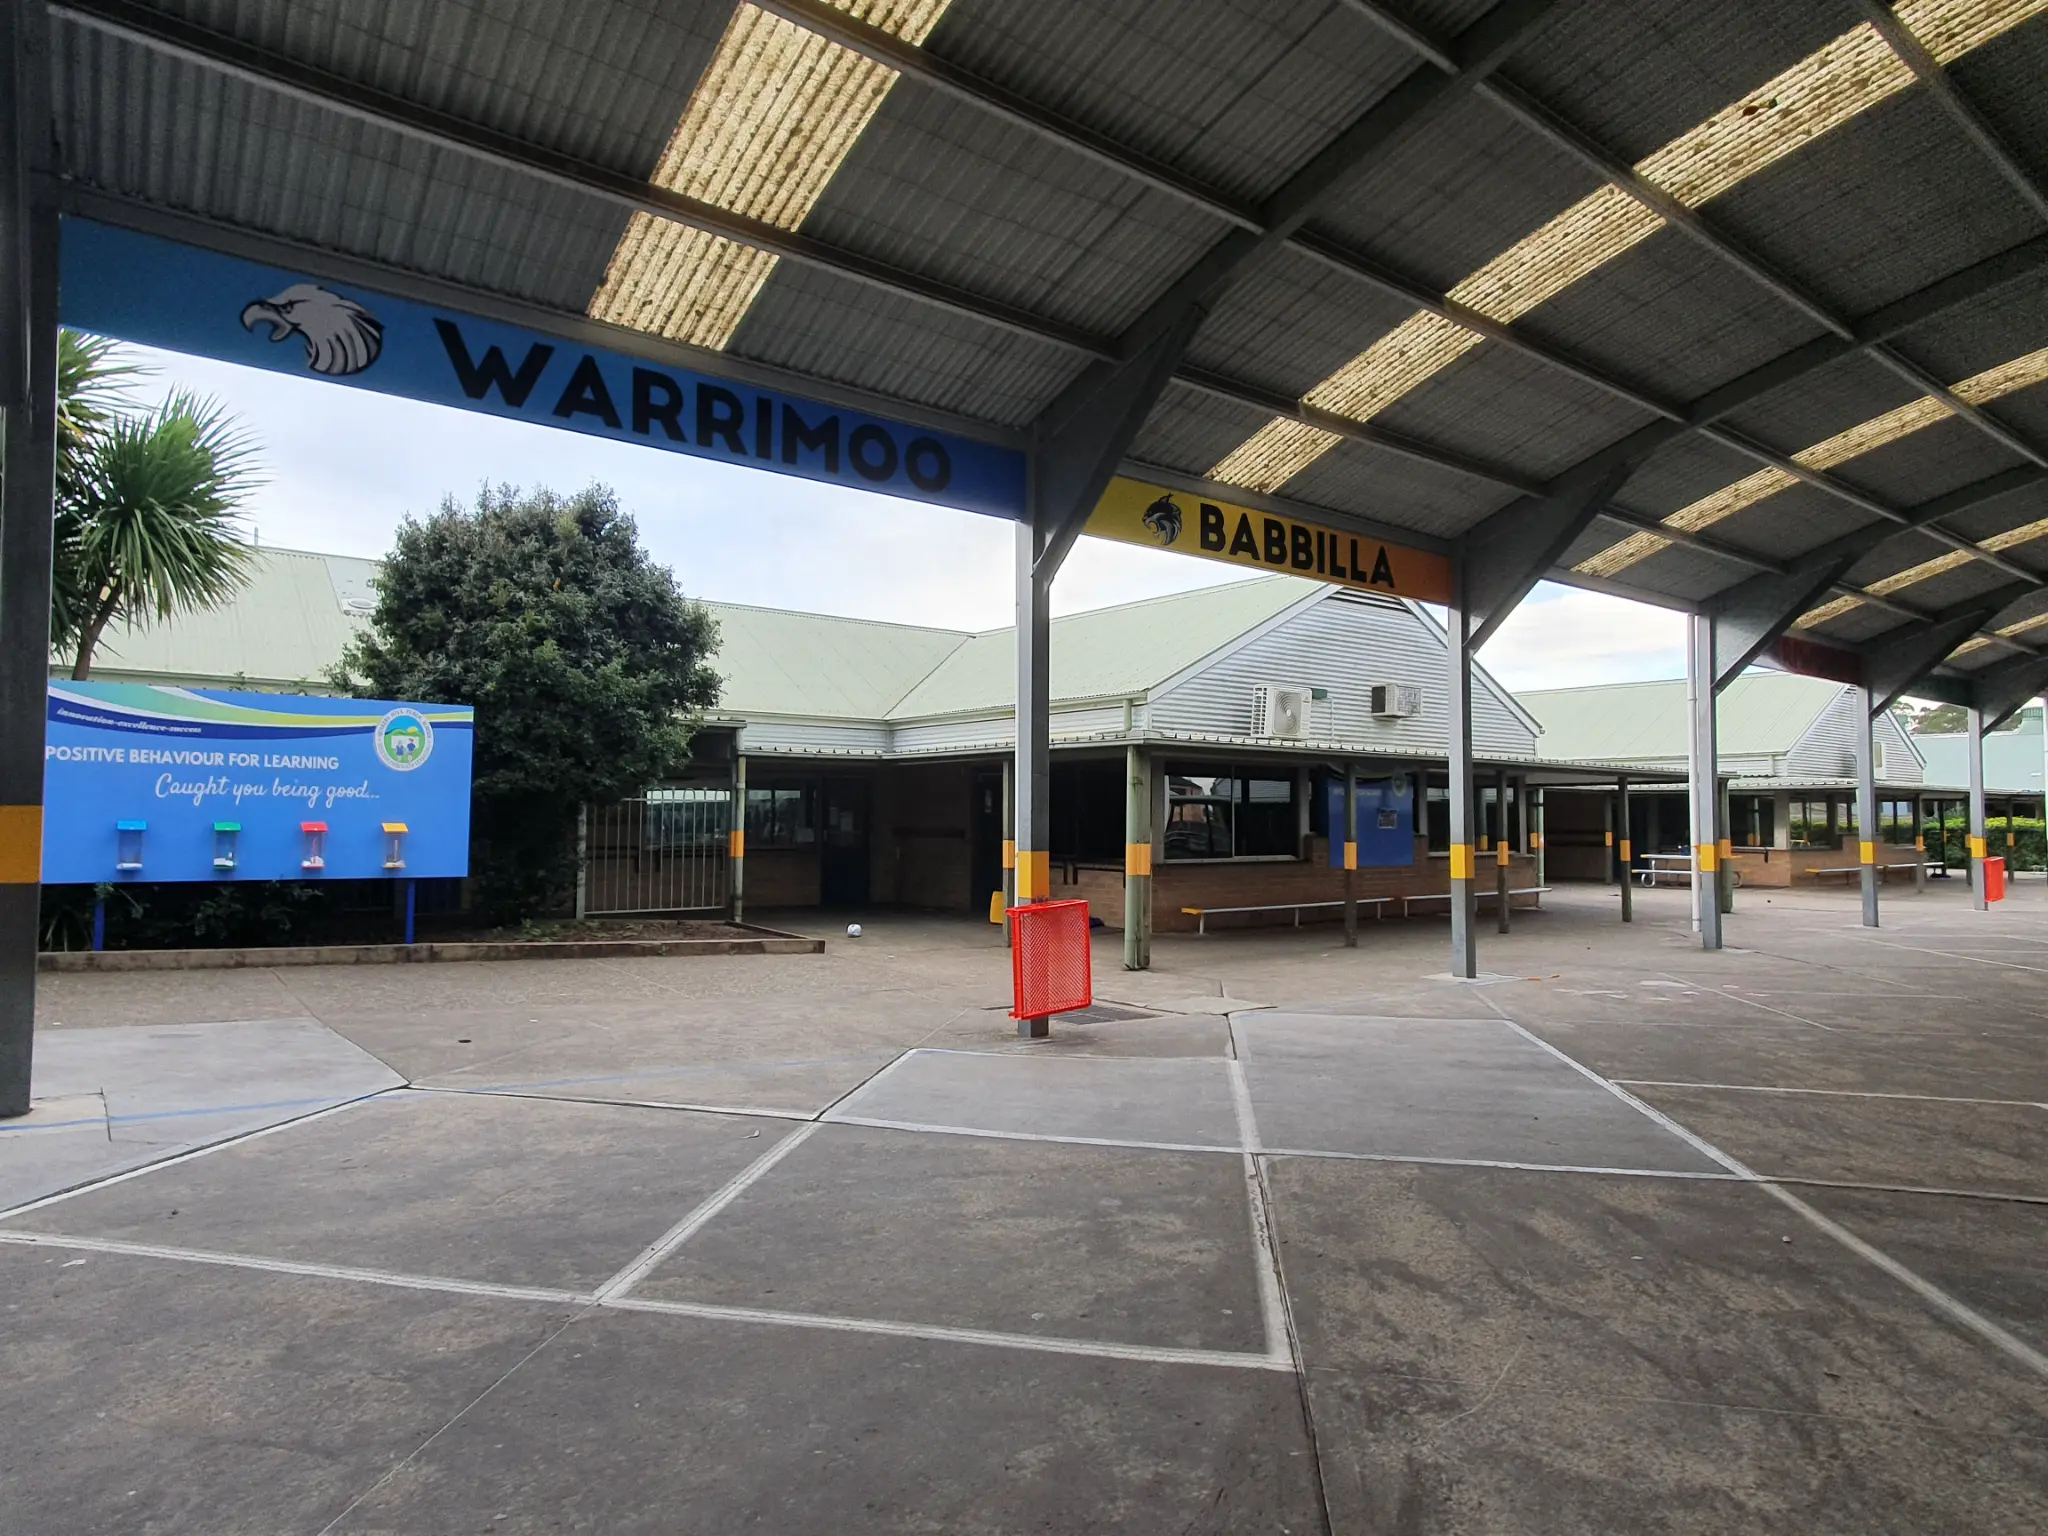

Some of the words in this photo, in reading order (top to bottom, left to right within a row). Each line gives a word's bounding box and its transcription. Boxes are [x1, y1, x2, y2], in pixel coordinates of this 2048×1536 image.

[431, 318, 953, 494] WARRIMOO
[1199, 502, 1395, 589] BABBILLA
[45, 746, 125, 763] POSITIVE
[129, 749, 225, 766] BEHAVIOUR
[229, 753, 260, 768] FOR
[264, 755, 339, 770] LEARNING
[155, 772, 230, 806] Caught
[232, 781, 268, 806] you
[272, 776, 322, 808] being
[325, 779, 380, 808] good...
